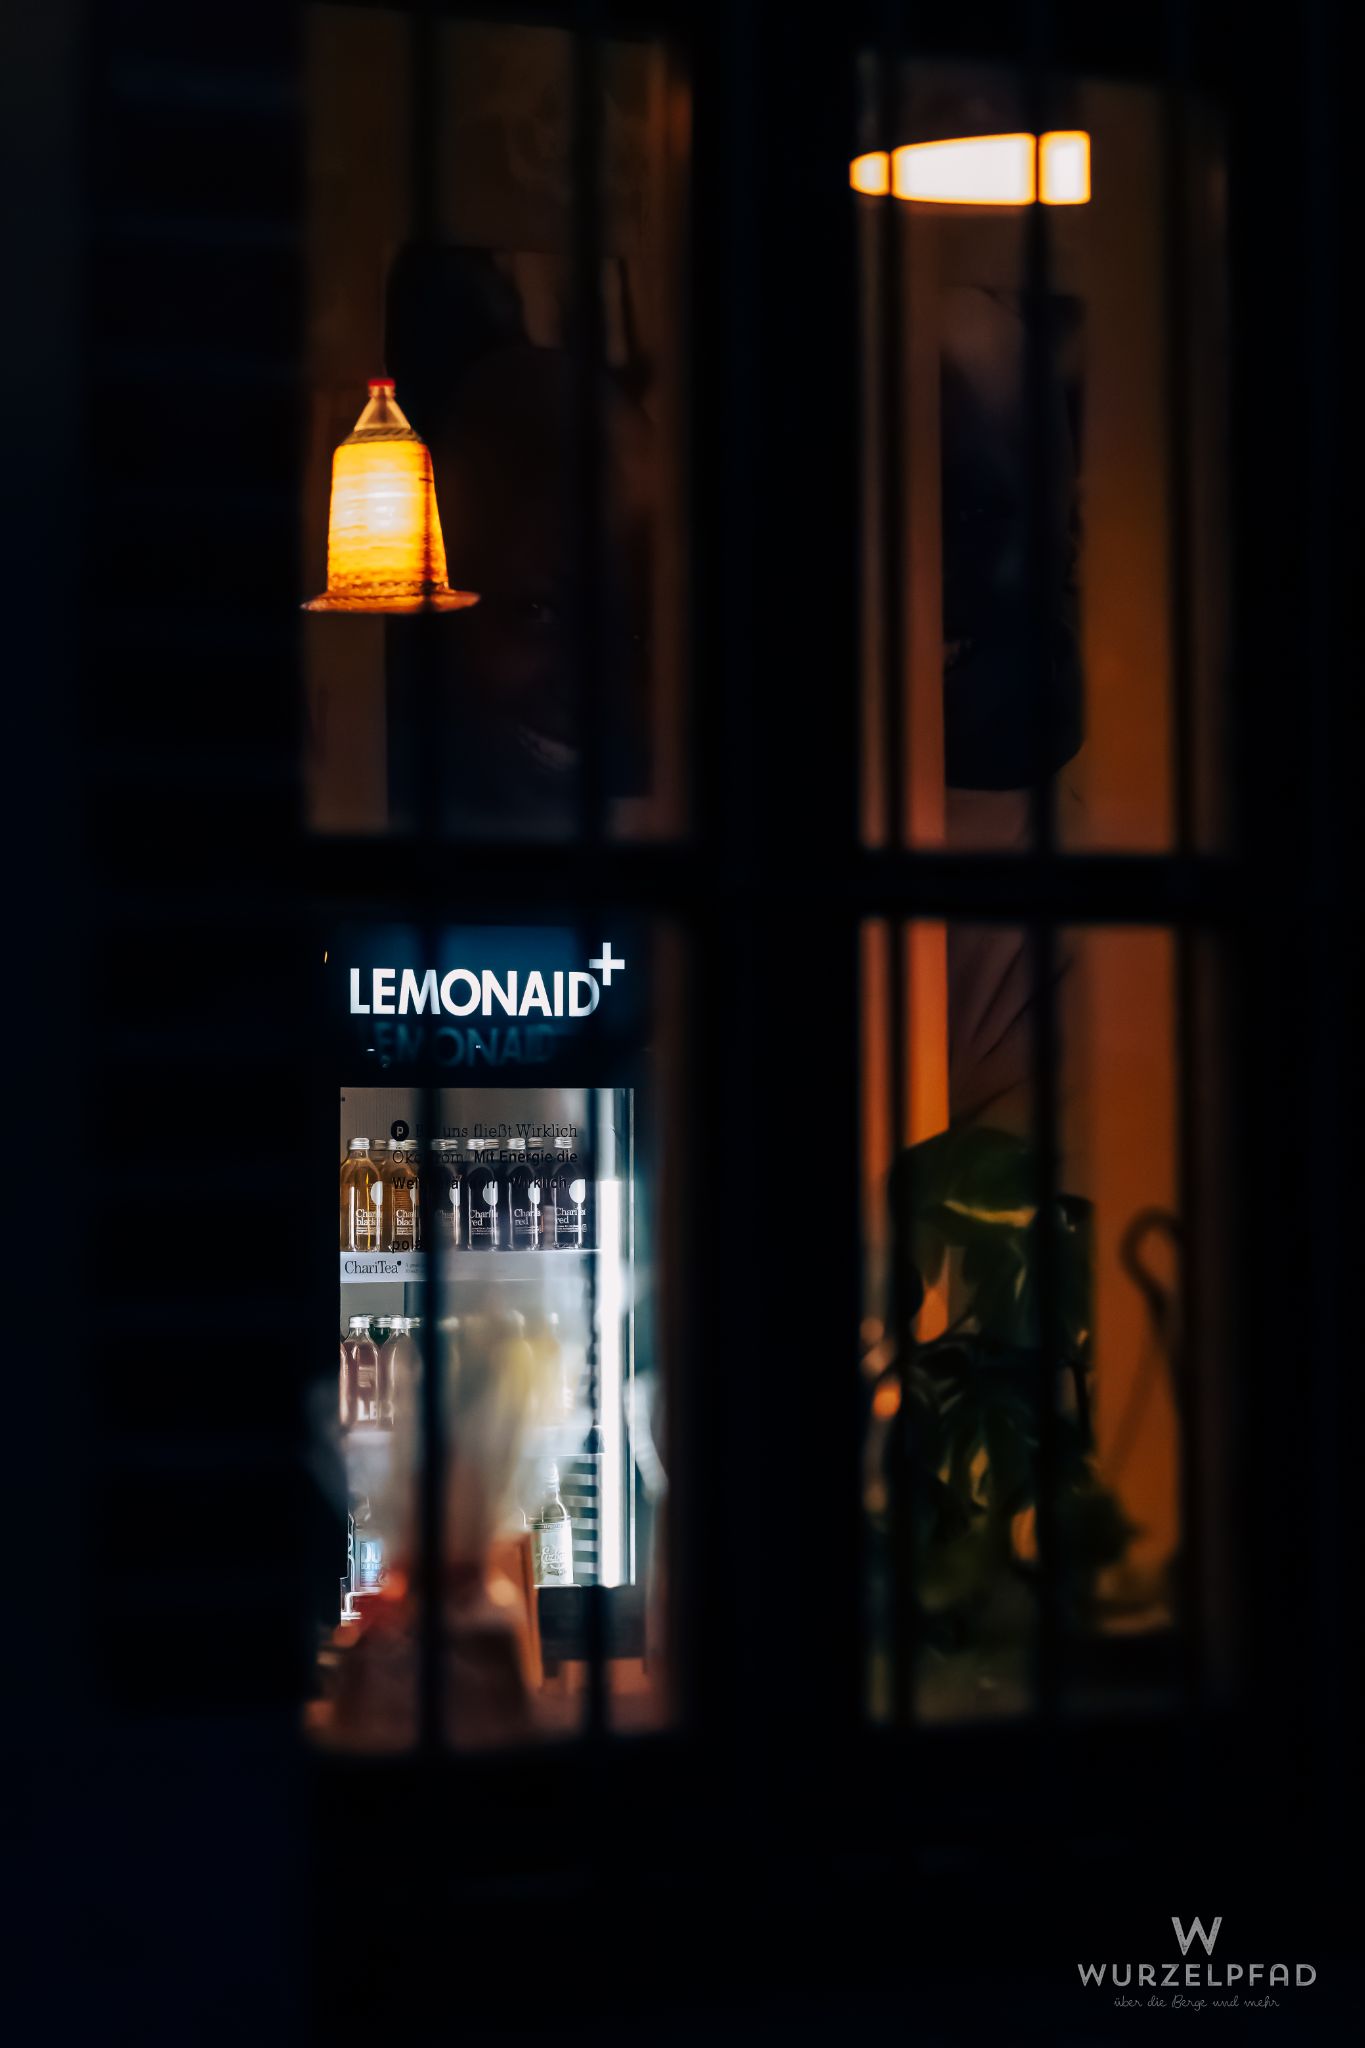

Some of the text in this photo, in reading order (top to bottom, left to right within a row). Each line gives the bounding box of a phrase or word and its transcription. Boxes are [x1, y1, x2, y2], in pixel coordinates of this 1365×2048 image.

[474, 1123, 512, 1138] fließt
[516, 1123, 578, 1138] Wirklich
[475, 1150, 496, 1163] Mit
[501, 1150, 551, 1166] Energie
[557, 1150, 578, 1163] die
[344, 1260, 399, 1274] ChariTea
